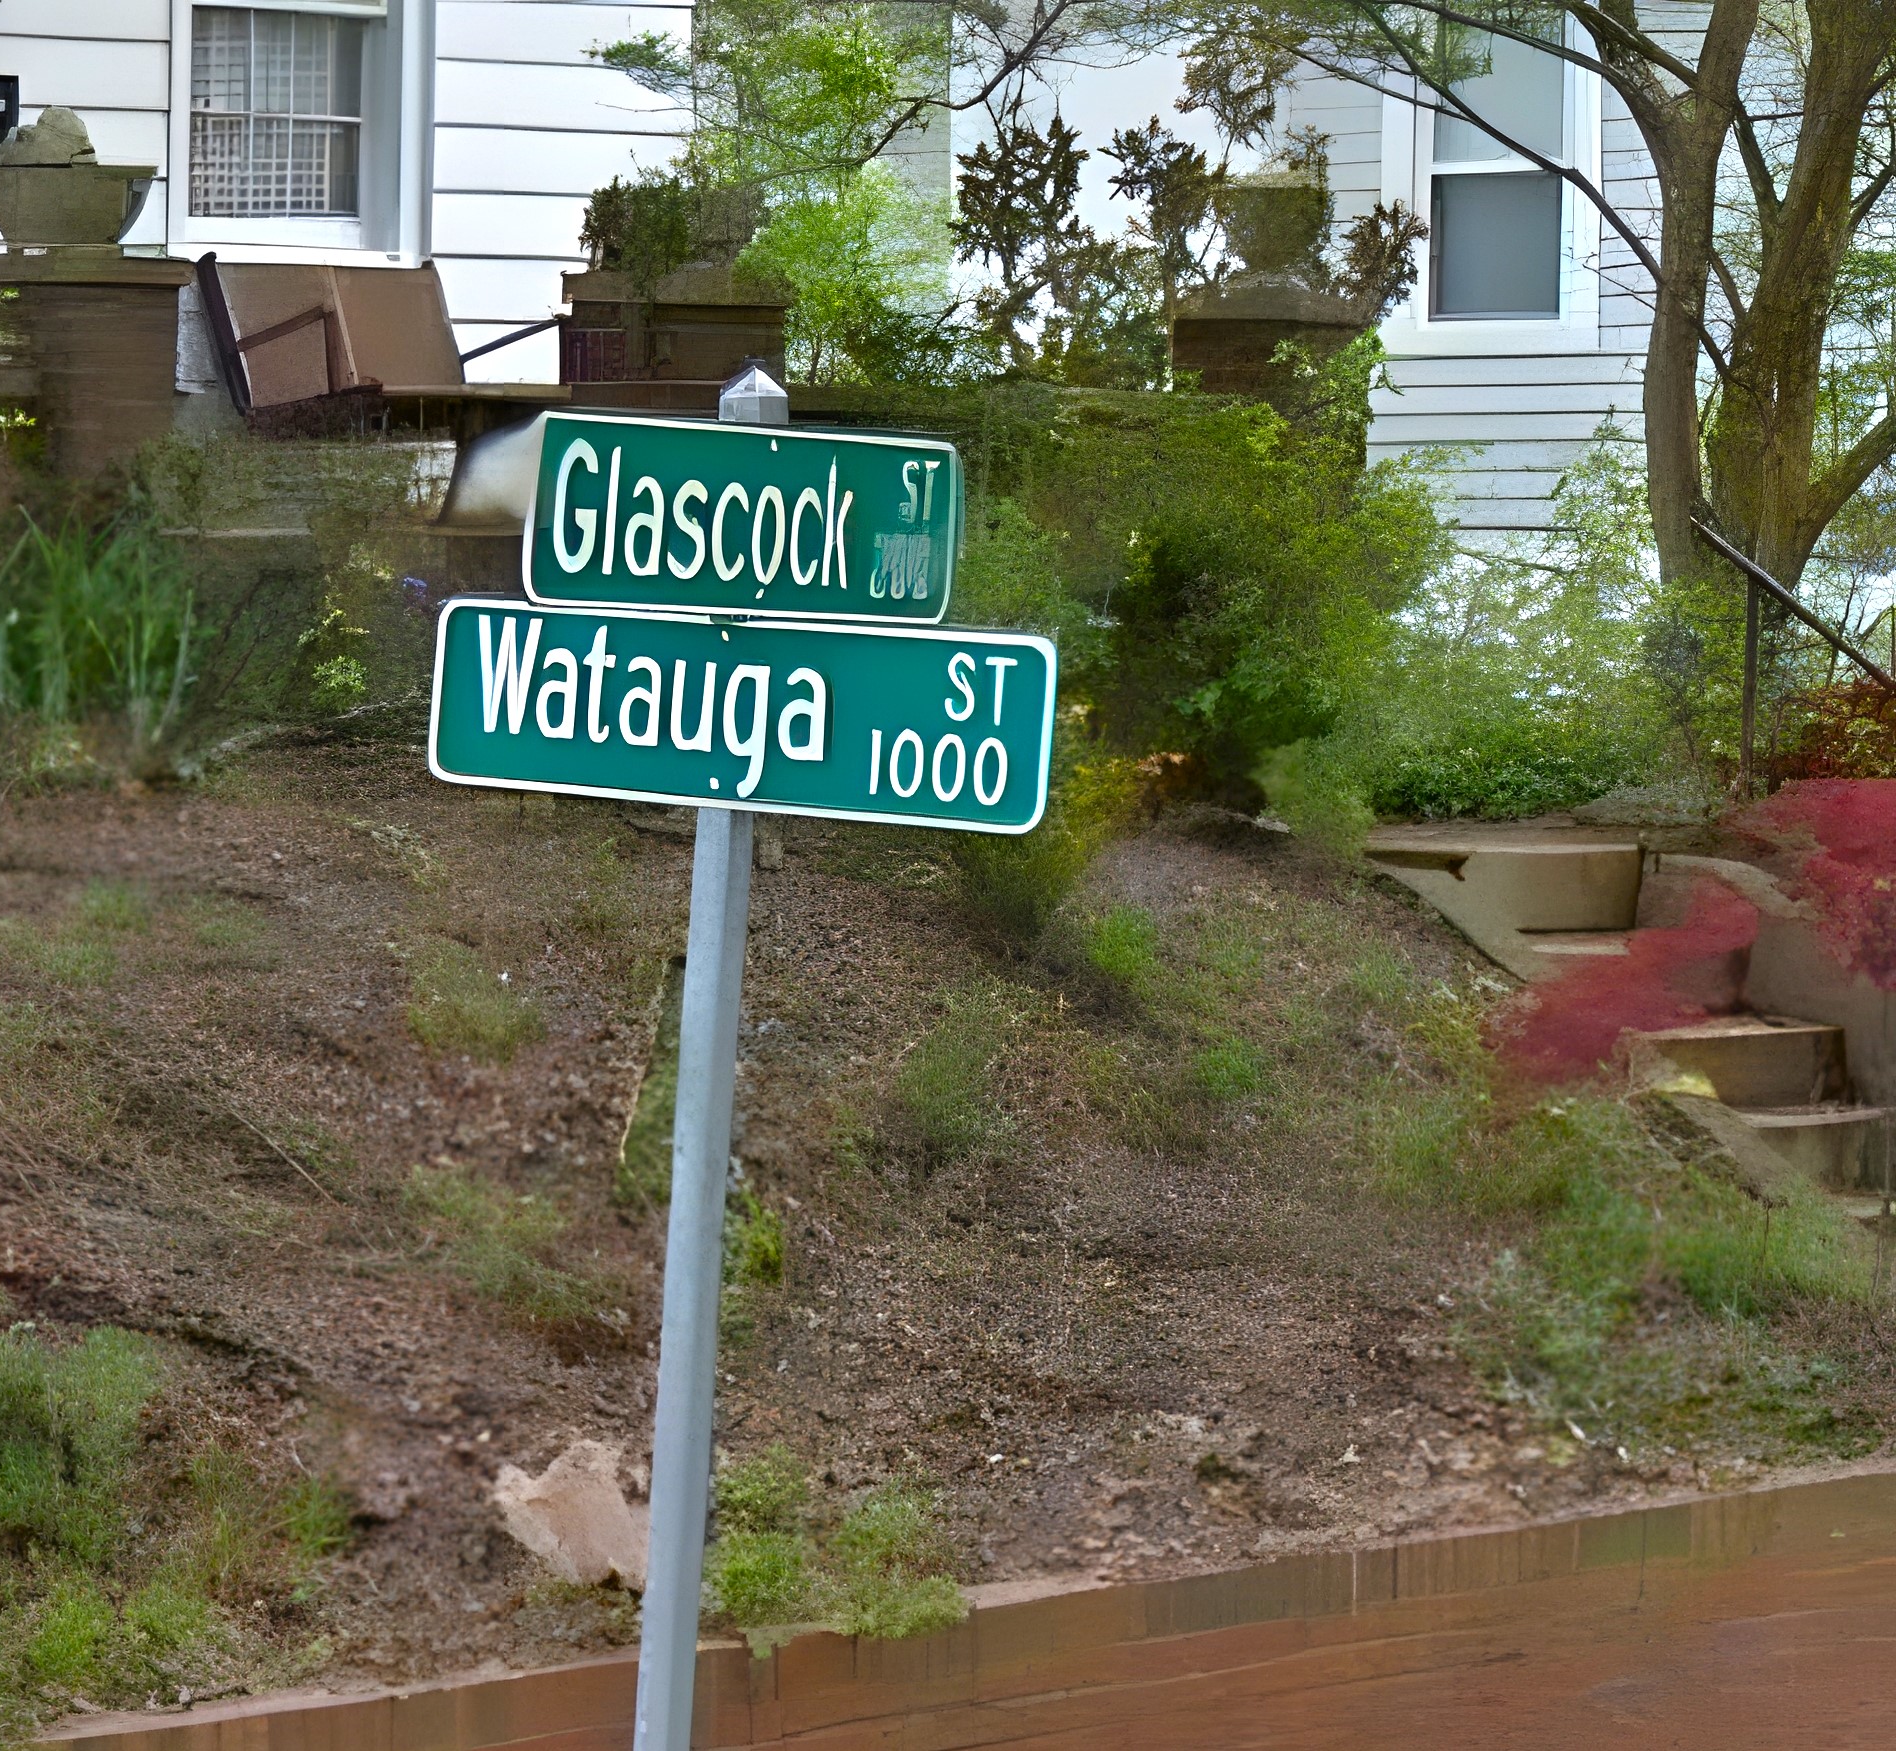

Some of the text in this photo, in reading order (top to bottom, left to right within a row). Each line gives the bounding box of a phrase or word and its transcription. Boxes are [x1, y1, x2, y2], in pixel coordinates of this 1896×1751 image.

[552, 437, 854, 590] Glascock
[899, 460, 941, 524] ST
[477, 614, 1018, 799] Watauga ST
[868, 729, 1009, 807] 1000
